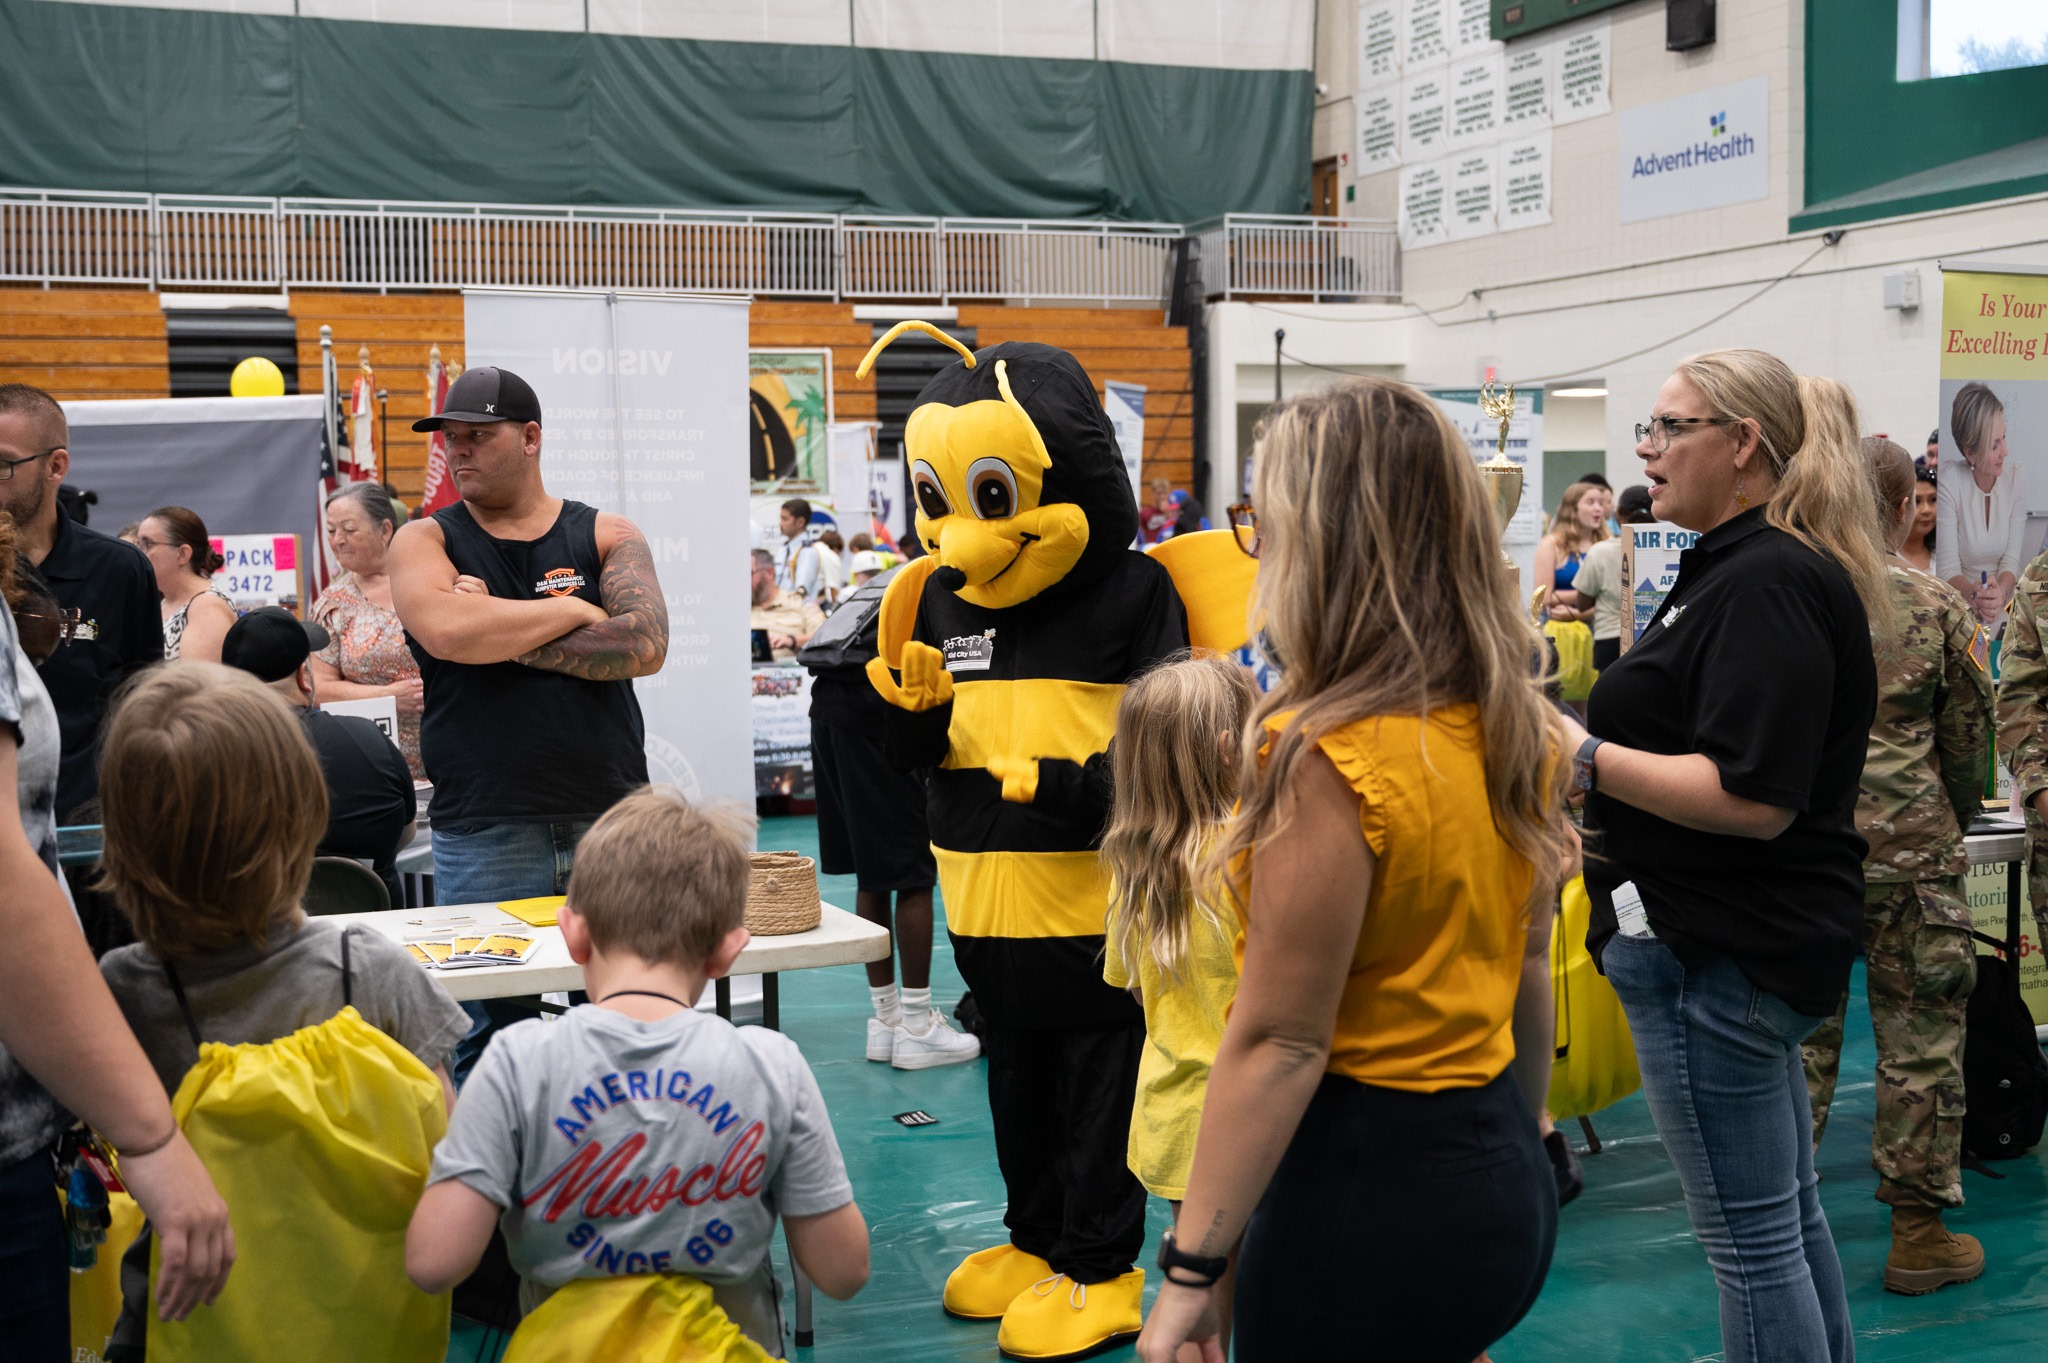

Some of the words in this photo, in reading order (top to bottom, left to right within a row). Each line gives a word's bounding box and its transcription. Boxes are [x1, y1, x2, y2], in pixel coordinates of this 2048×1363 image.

[1632, 133, 1755, 179] AdventHealth
[1979, 293, 1996, 317] Is
[2002, 294, 2047, 319] Your
[1946, 329, 2038, 361] Excelling
[1634, 531, 1661, 548] AIR
[226, 549, 274, 566] PACK
[229, 575, 273, 593] 3472
[1660, 575, 1678, 586] AF
[1973, 918, 1989, 928] akes
[555, 1068, 740, 1145] AMERICAN
[522, 1119, 766, 1223] Muscle
[566, 1222, 670, 1274] SINCE
[687, 1218, 735, 1265] 66
